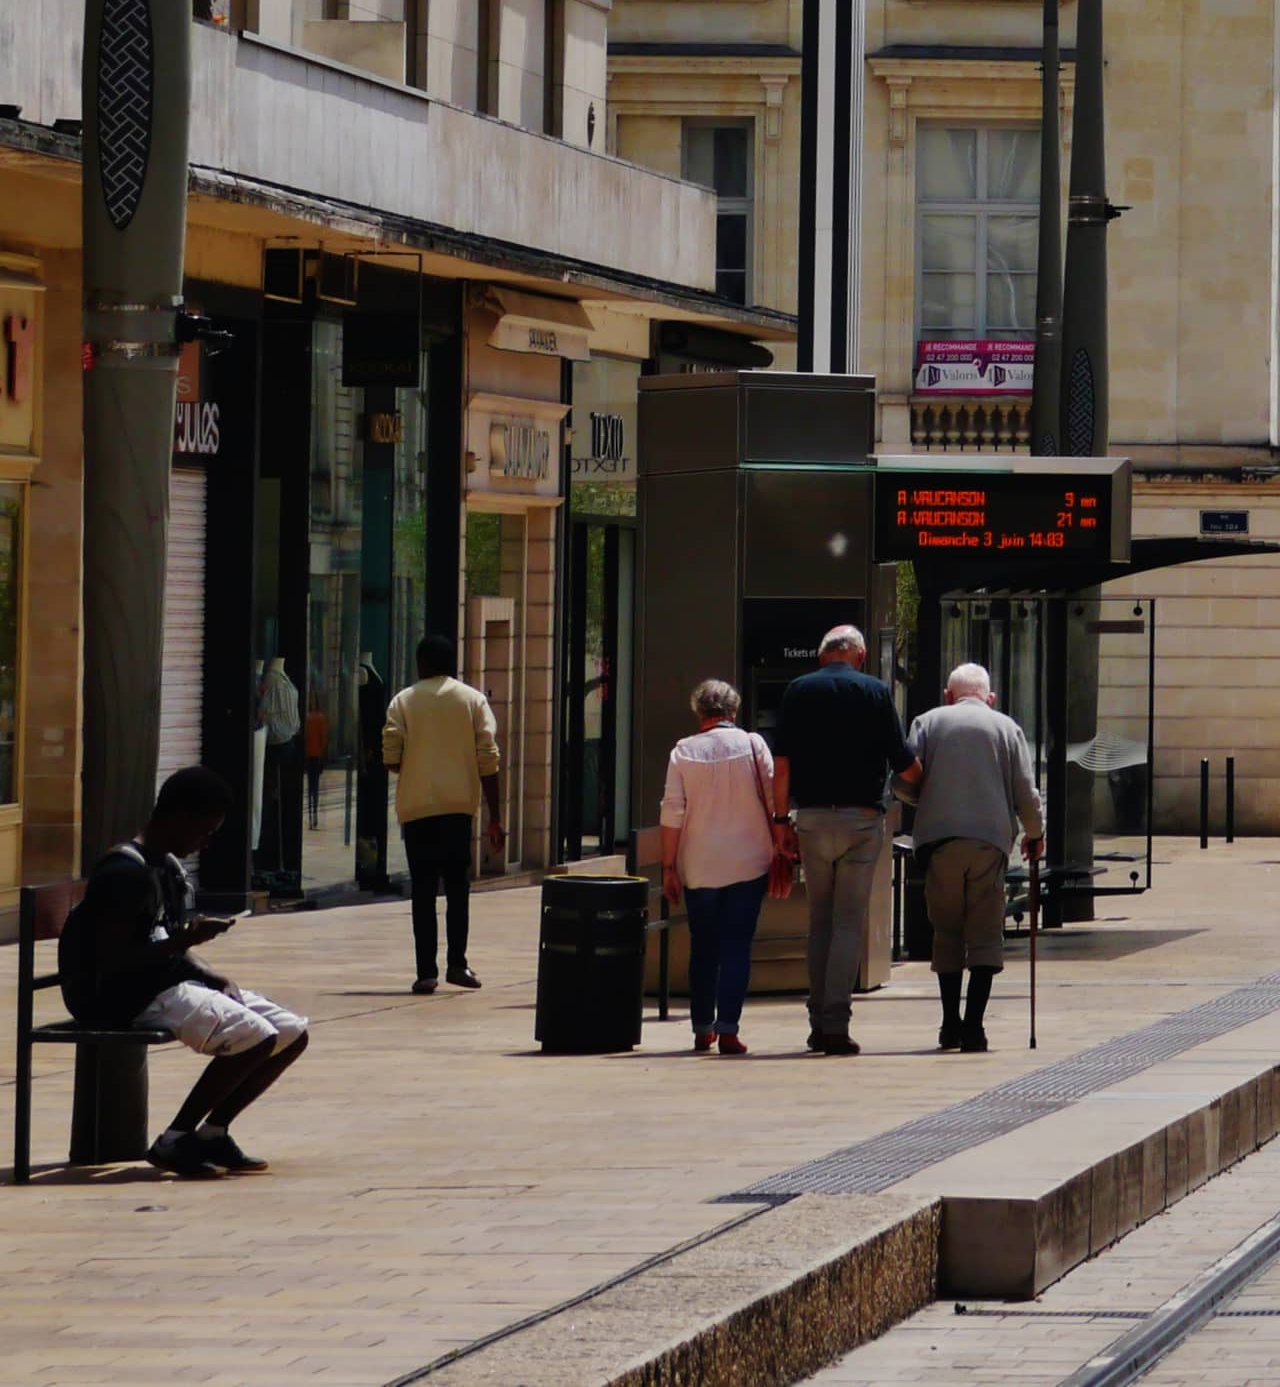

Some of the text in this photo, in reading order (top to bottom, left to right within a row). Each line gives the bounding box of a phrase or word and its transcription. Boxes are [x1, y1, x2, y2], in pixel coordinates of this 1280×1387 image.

[590, 411, 624, 461] TEXTO
[897, 490, 906, 506] A
[1064, 492, 1074, 508] 9
[897, 511, 906, 526] A
[1056, 513, 1073, 528] 21
[918, 531, 1065, 549] Dimanche 3 juin 14:03
[784, 647, 808, 659] Tickets
